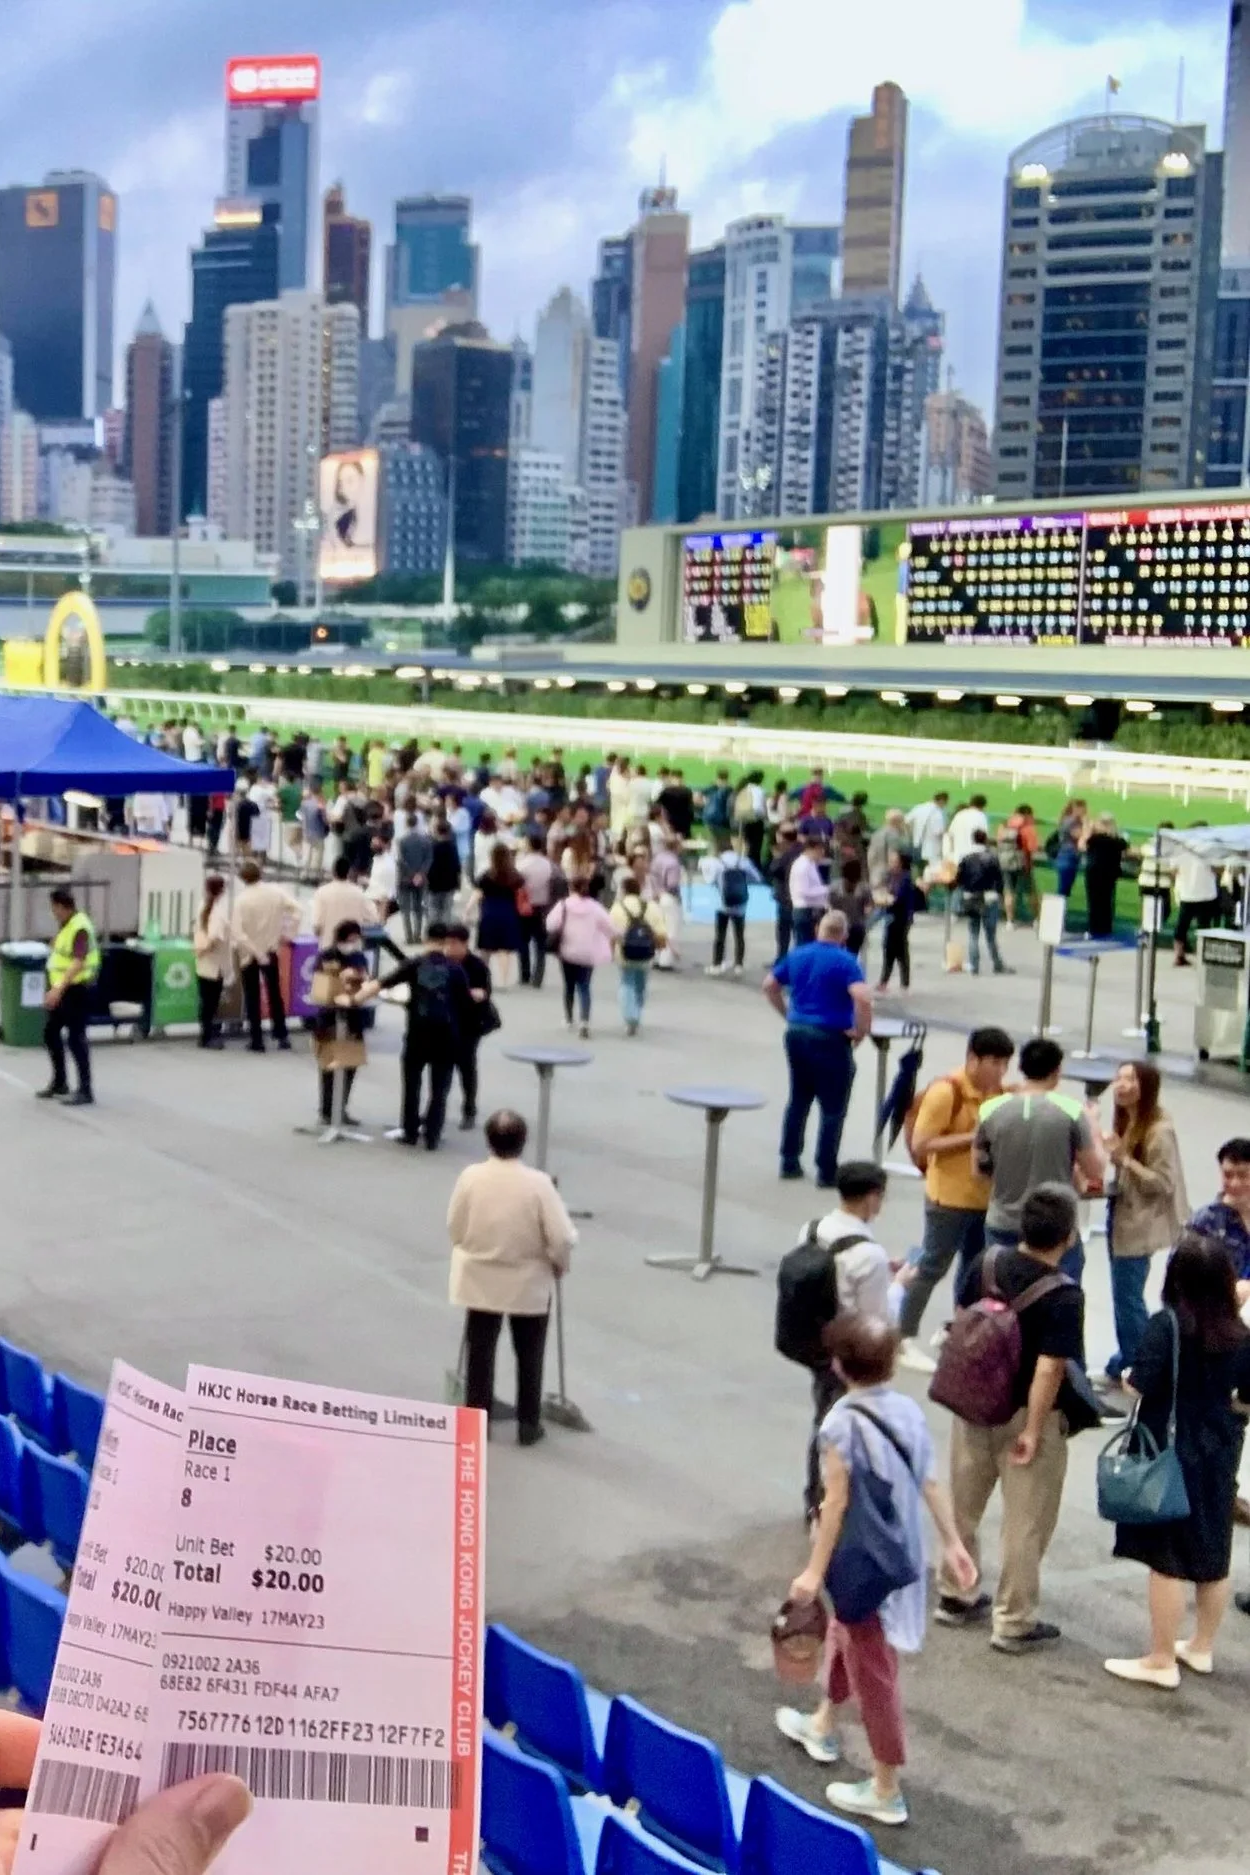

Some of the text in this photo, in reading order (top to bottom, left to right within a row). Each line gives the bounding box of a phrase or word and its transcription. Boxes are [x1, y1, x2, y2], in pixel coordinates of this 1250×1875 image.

[162, 1402, 184, 1422] Rac
[198, 1381, 447, 1430] HKJC Horse Race Betting Limited
[188, 1429, 237, 1454] Place
[184, 1460, 231, 1482] Race 1
[181, 1487, 192, 1508] 8
[176, 1534, 322, 1566] Unit Bet $20.00
[173, 1560, 324, 1593] Total $20.00
[457, 1441, 475, 1757] THE HONG KONG JOCKEY CLUB
[168, 1602, 325, 1630] Happy Valley 17MAY23
[162, 1653, 260, 1675] 0921002 2A36
[206, 1678, 248, 1696] 6F431
[453, 1851, 468, 1875] TH
